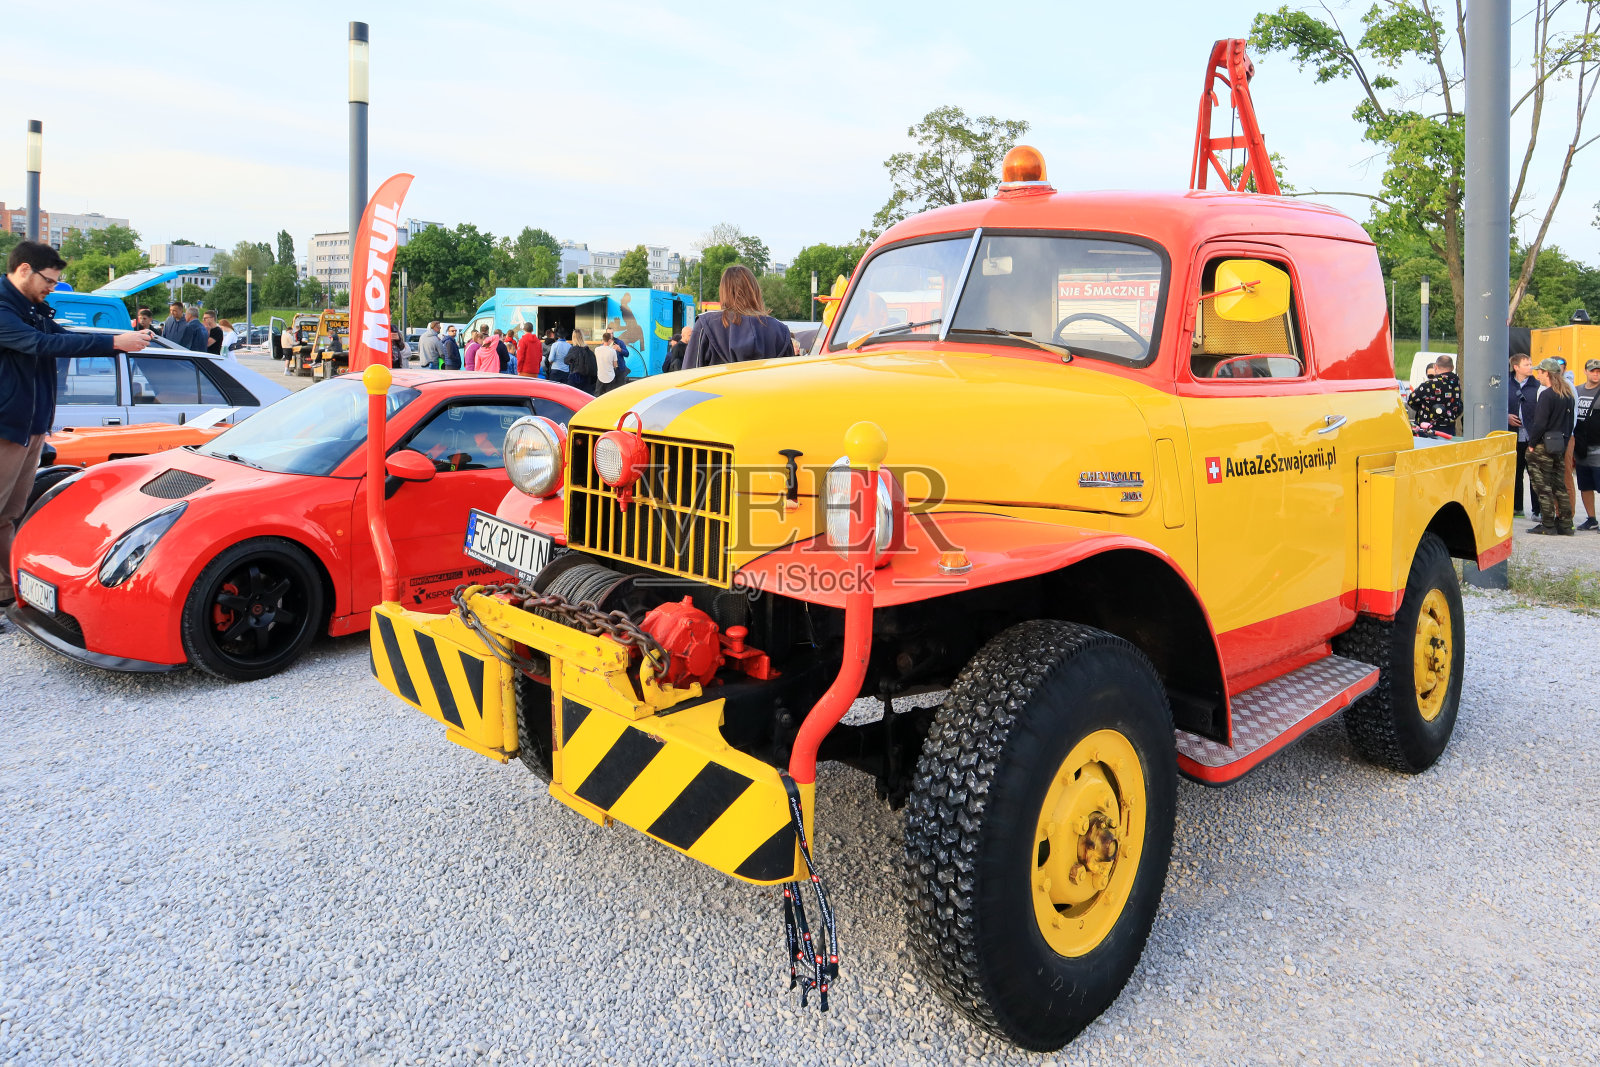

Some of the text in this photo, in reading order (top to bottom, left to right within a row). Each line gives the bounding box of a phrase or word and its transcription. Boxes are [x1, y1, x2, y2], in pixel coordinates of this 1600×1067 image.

[362, 201, 400, 354] MOTUL
[1083, 283, 1145, 297] SMACZNE
[1149, 283, 1160, 297] P
[1225, 446, 1337, 478] AutaZeSzwajcarii.pl
[1079, 471, 1142, 481] CHEVROLET
[426, 588, 456, 600] KSPOR
